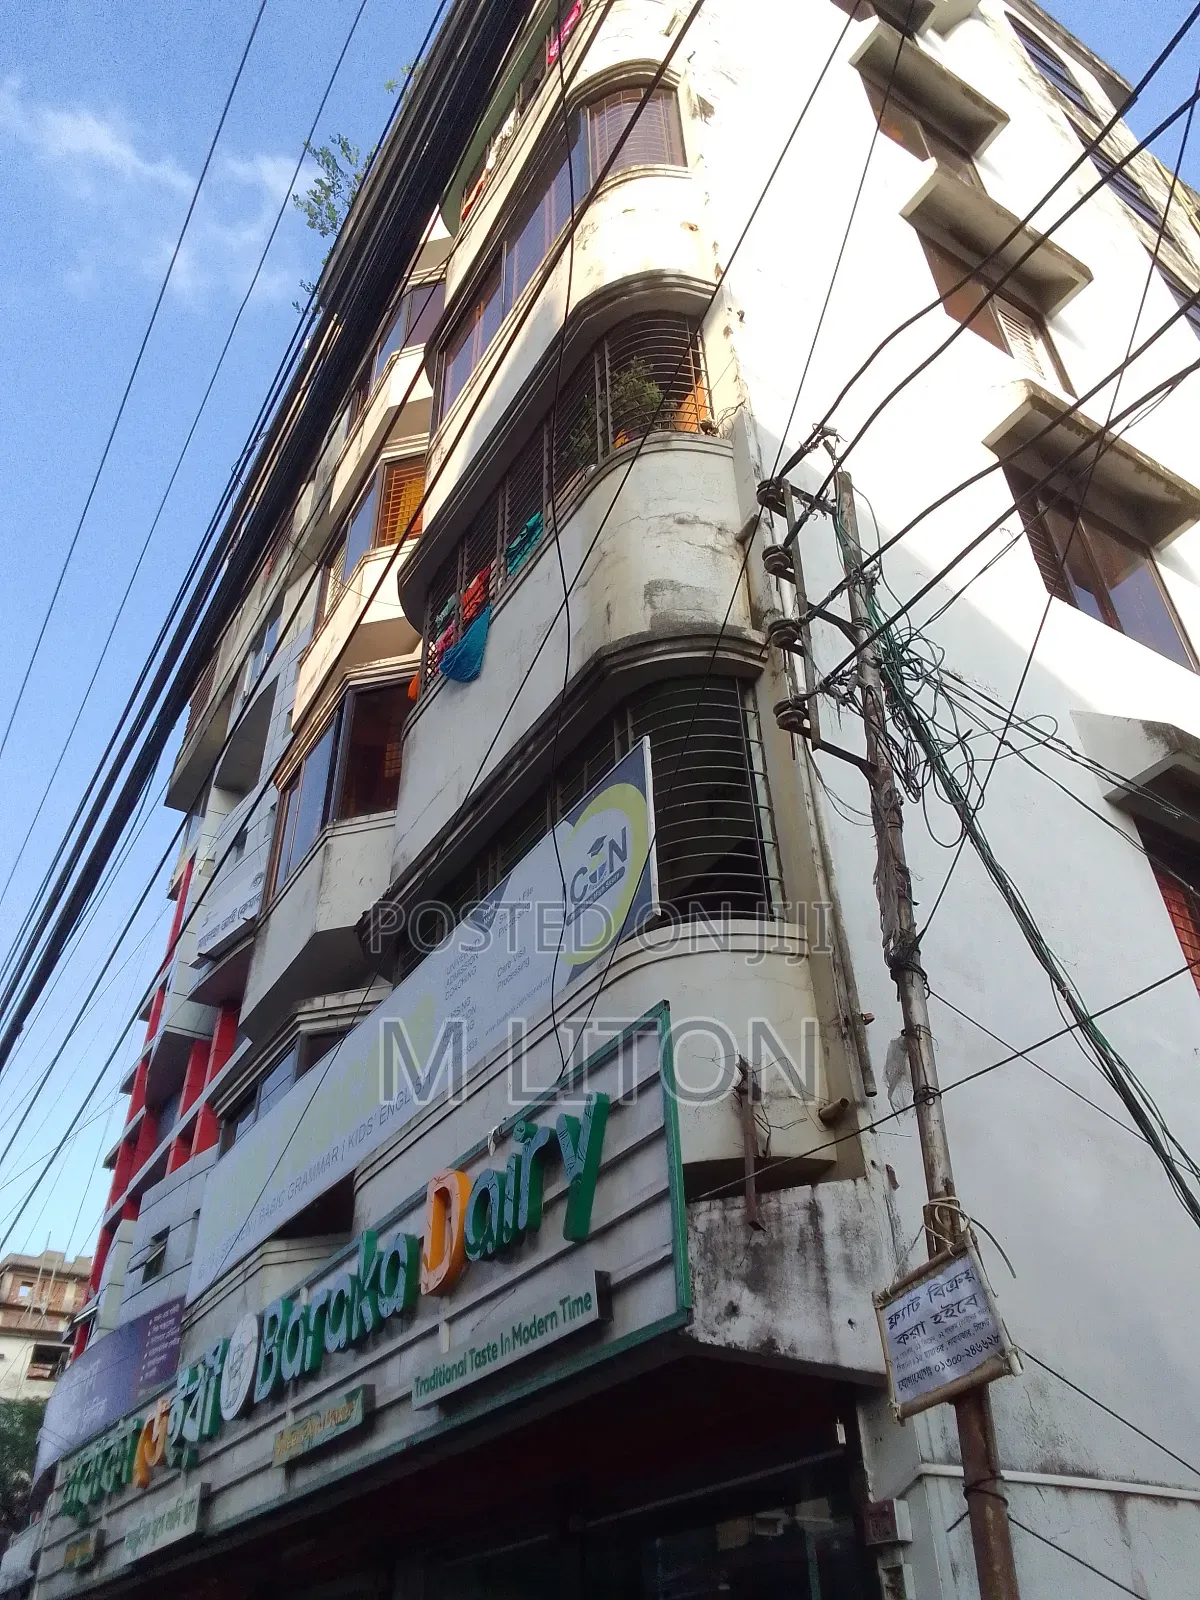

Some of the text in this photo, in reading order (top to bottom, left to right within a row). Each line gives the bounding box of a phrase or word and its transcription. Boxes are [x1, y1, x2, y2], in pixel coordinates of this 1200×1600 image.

[287, 1145, 339, 1202] GRAMMAR
[254, 1230, 420, 1403] Baraka
[421, 1090, 610, 1296] Dairy
[414, 1292, 592, 1397] Traditional Taste In Modern Time
[893, 1320, 928, 1345] করা
[930, 1292, 979, 1325] হইবে
